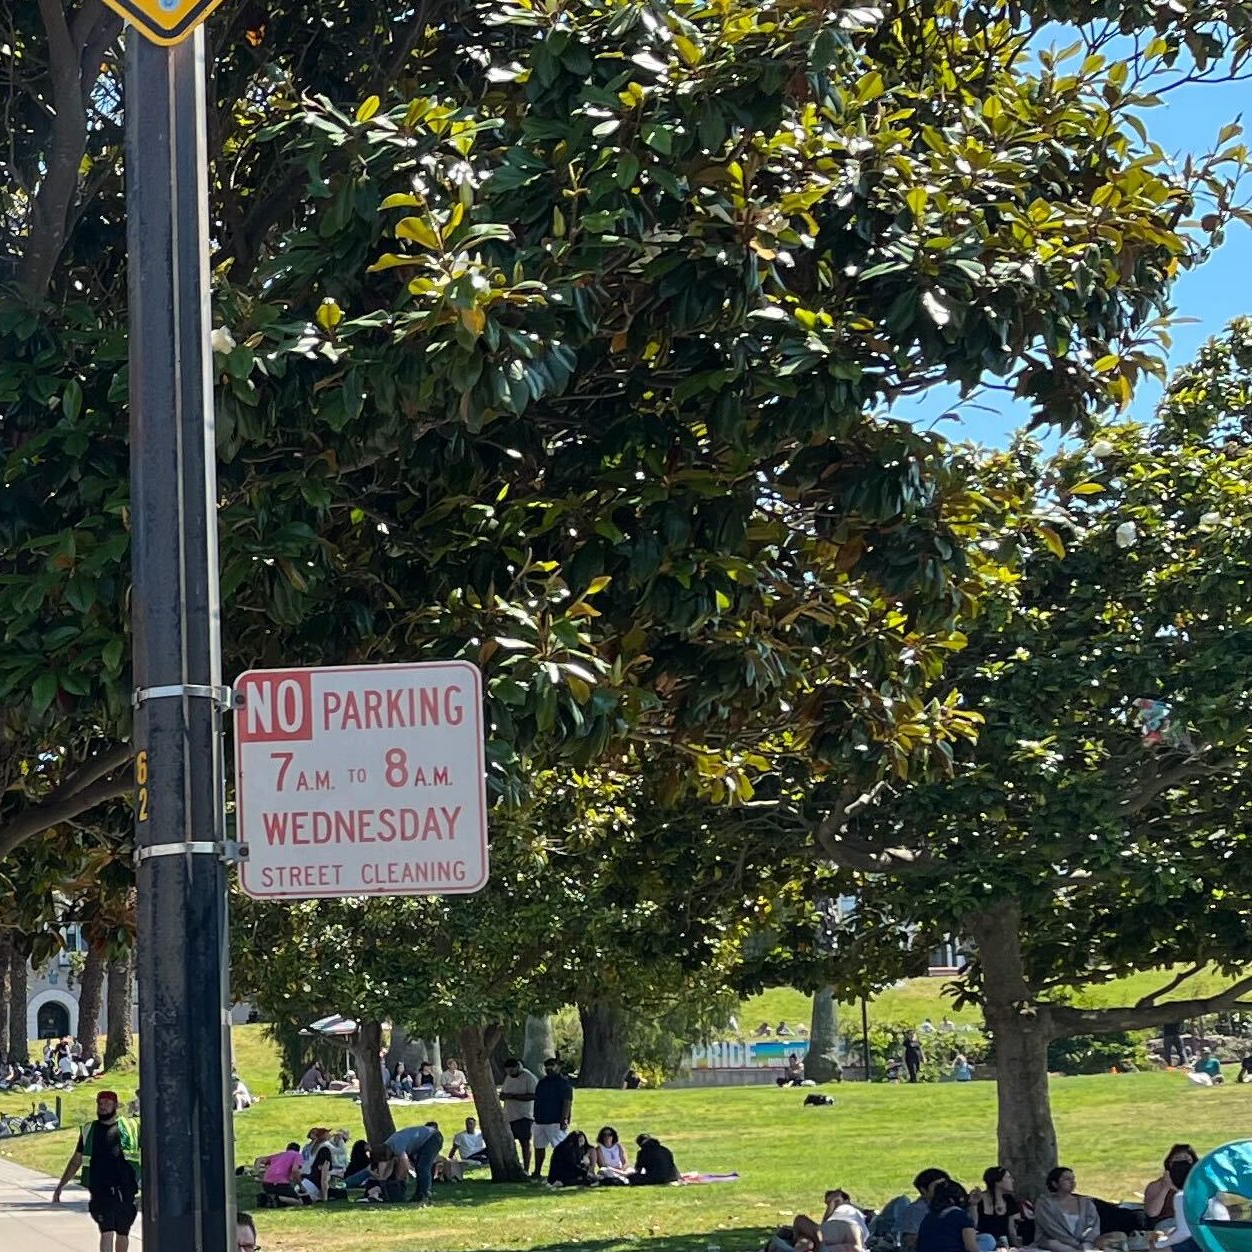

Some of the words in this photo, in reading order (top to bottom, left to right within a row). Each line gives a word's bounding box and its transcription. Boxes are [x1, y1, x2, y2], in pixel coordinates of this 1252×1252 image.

[247, 678, 306, 736] NO
[323, 685, 464, 731] PARKING
[348, 768, 366, 783] TO
[263, 806, 462, 846] WEDNESDAY
[261, 865, 343, 888] STREET
[361, 860, 466, 885] CLEANING
[691, 1042, 757, 1068] PRIDE
